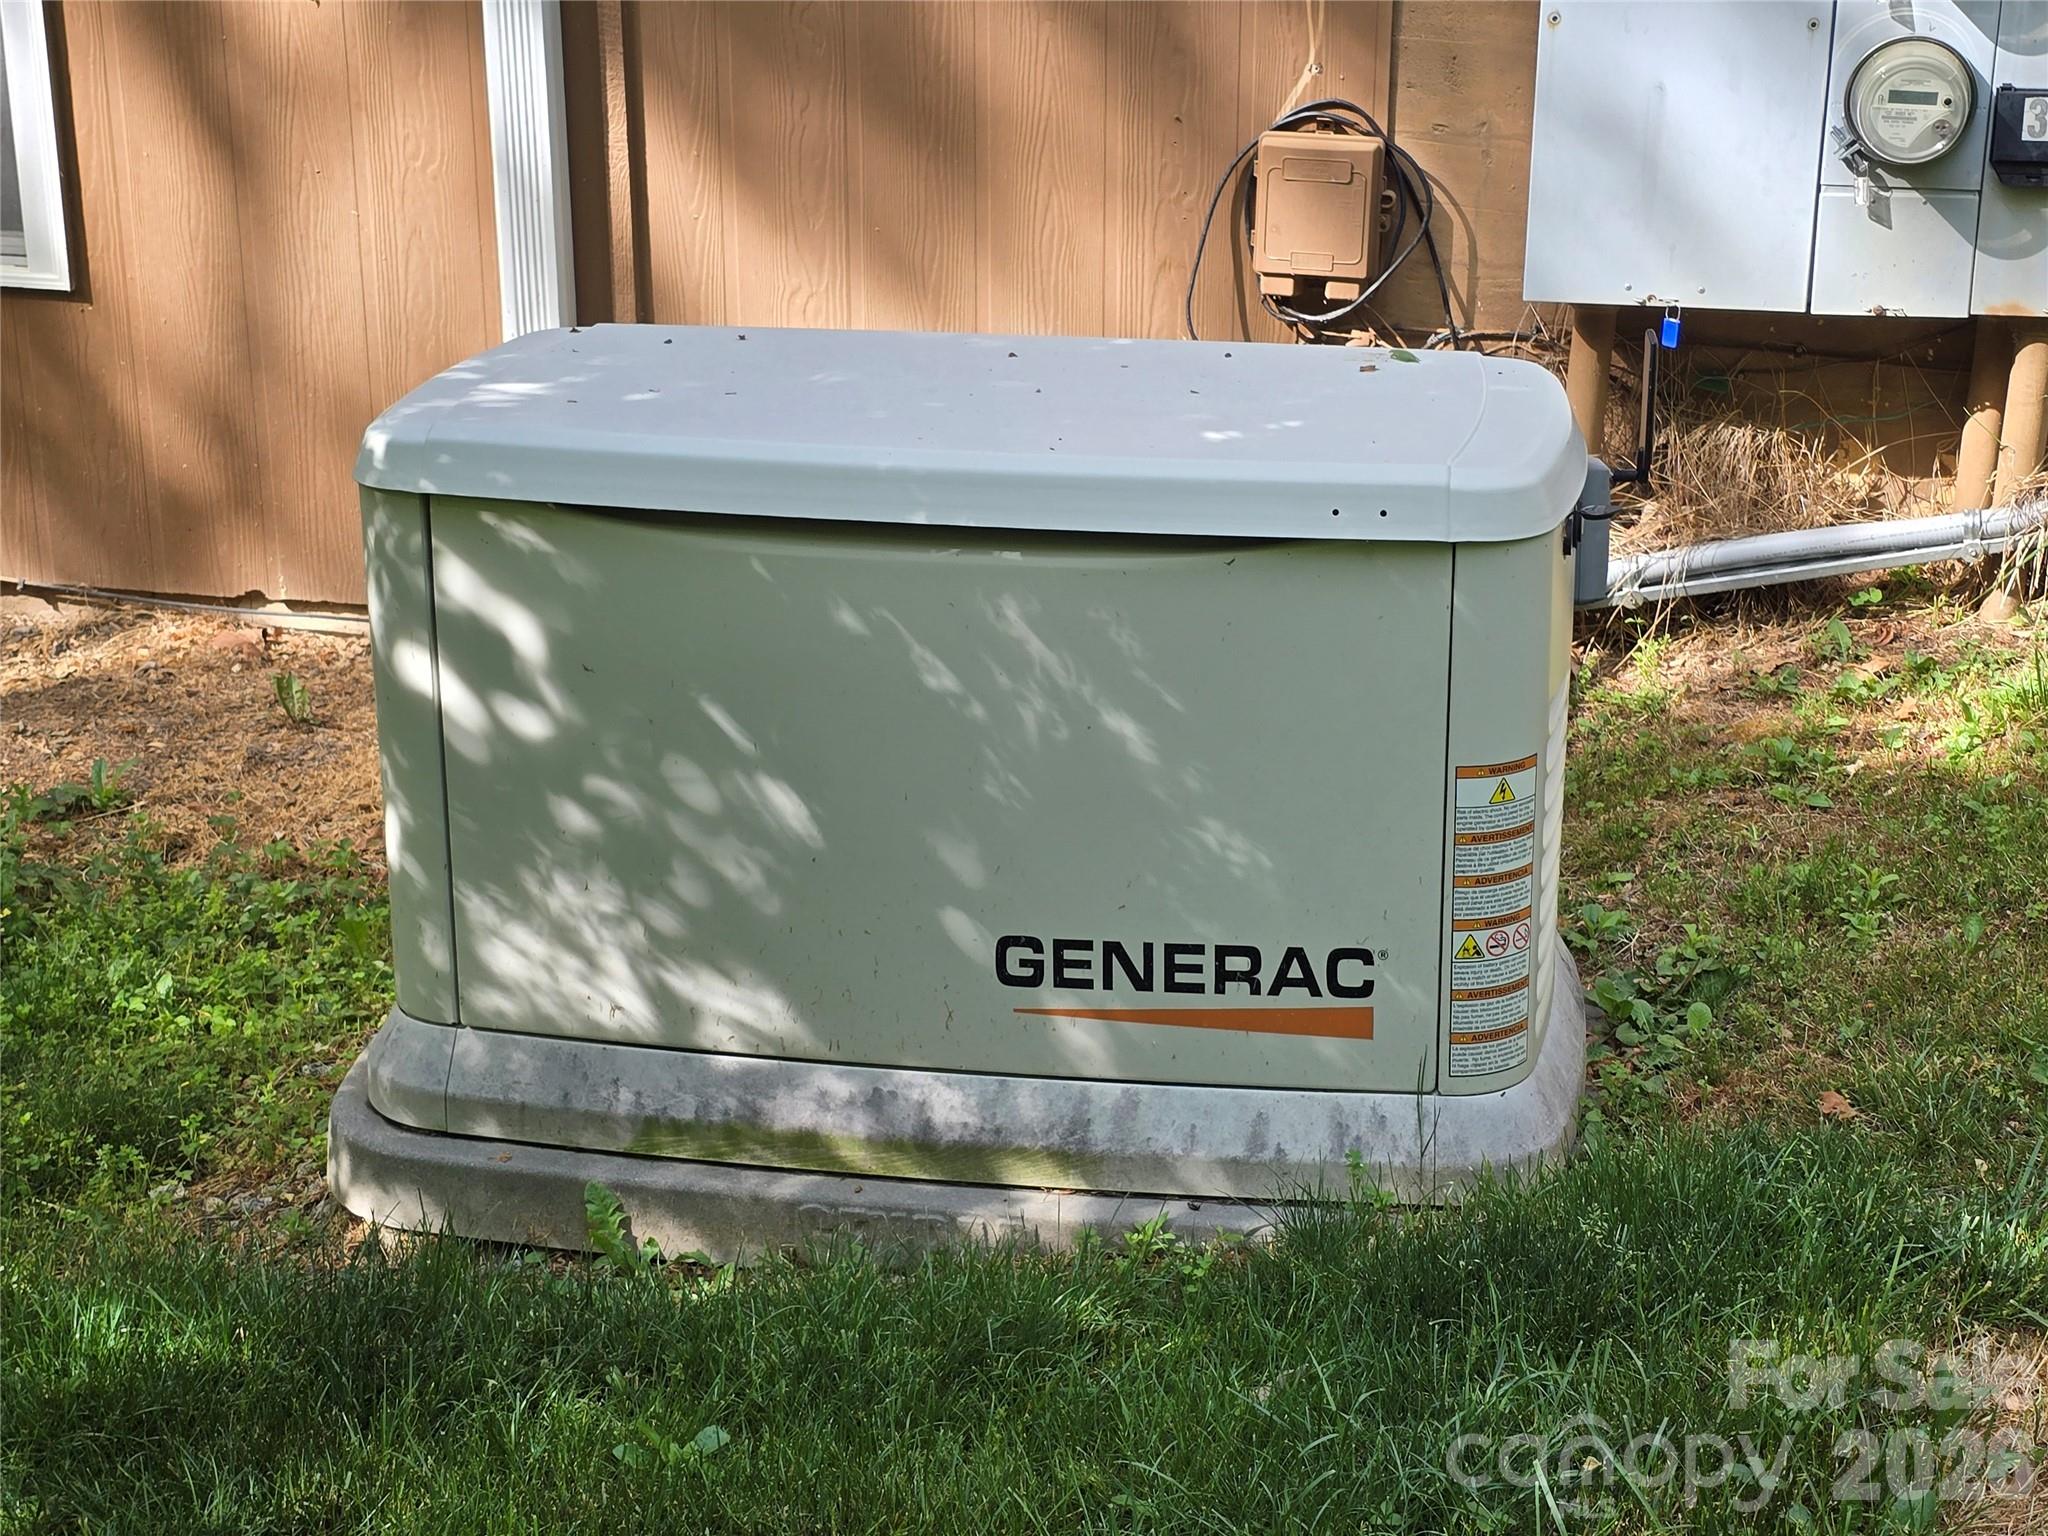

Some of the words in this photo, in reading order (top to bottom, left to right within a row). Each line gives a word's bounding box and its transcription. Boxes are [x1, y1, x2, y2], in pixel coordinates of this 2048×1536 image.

[2027, 98, 2048, 139] 3
[1488, 760, 1526, 776] WARNING
[1470, 823, 1533, 843] AVERTISSEMENT
[1474, 868, 1528, 886] ADVERTENCIA
[1484, 913, 1521, 928] WARNING
[995, 935, 1375, 999] GENERAC
[1467, 980, 1529, 999] AVERTISSEMENT
[1471, 1023, 1524, 1042] ADVERTENCIA
